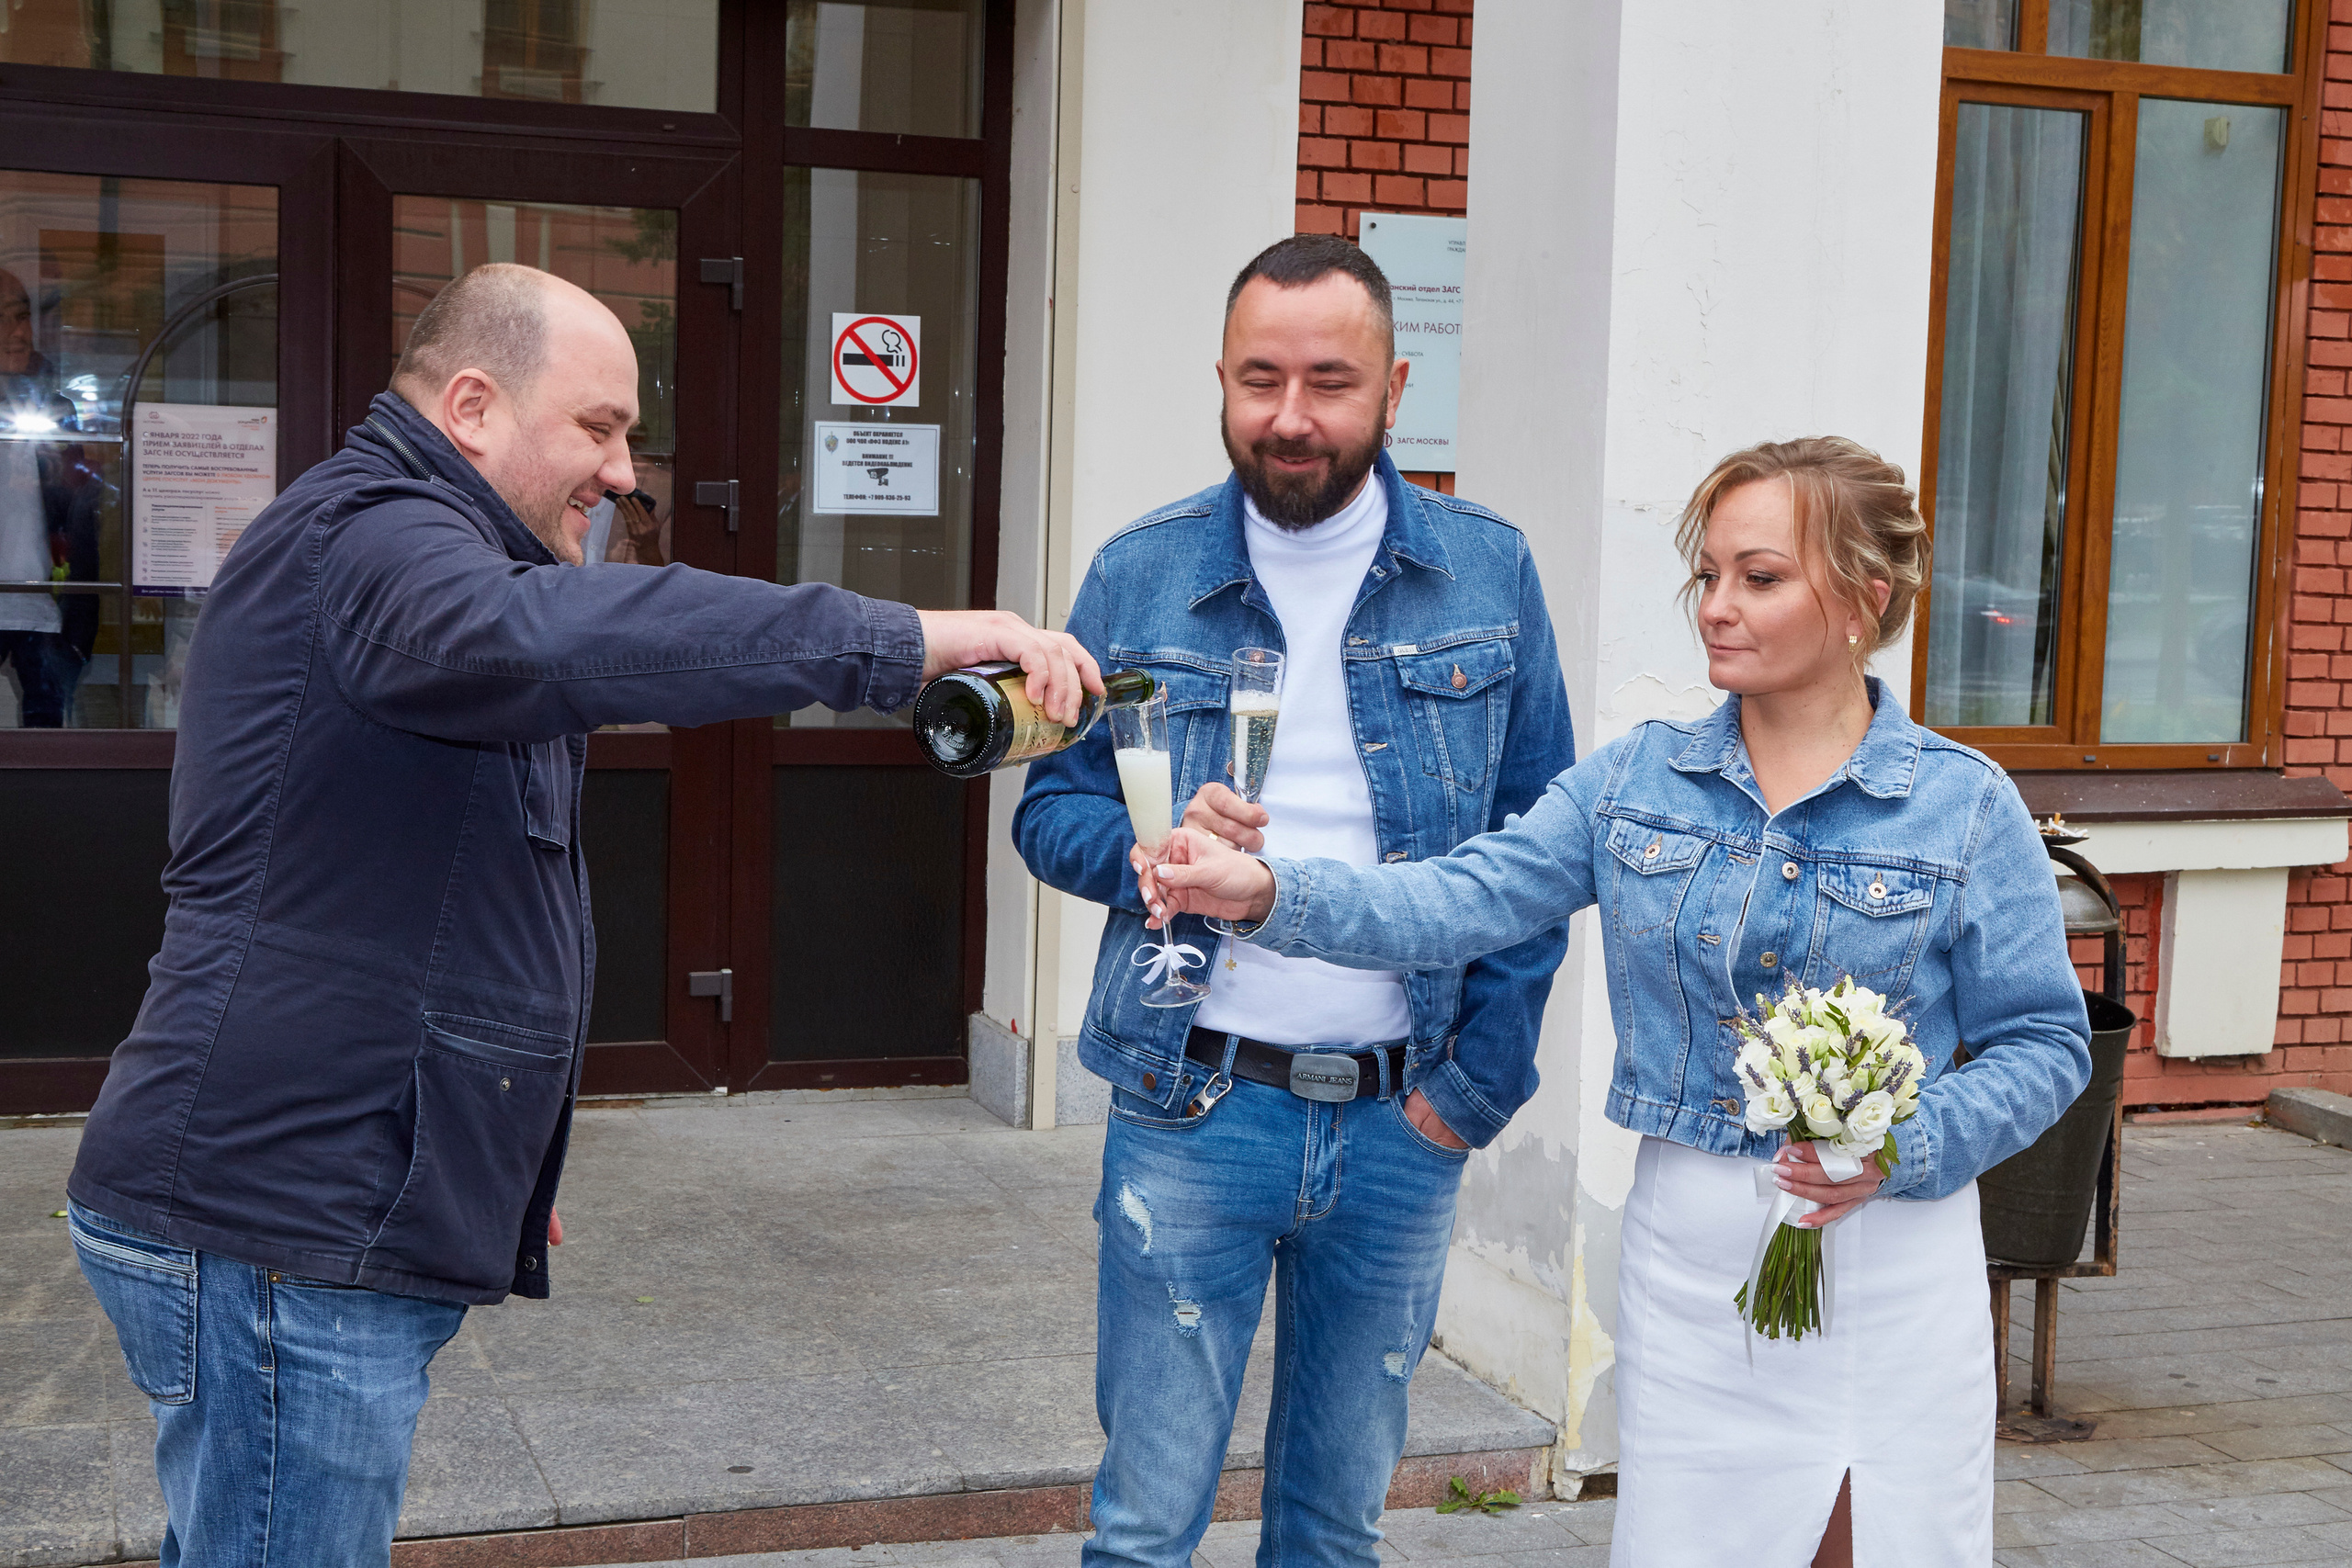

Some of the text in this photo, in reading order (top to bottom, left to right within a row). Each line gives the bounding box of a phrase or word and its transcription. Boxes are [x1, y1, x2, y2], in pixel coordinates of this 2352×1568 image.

[1442, 285, 1461, 294] ЗАГС
[1423, 321, 1463, 335] РАБОТ
[1396, 436, 1415, 445] ЗАГС
[172, 441, 220, 450] ЗАЯВИТЕЛЕЙ
[142, 448, 162, 457] ЗАГС
[175, 450, 245, 458] ОСУЩЕСТВЛЯЕТСЯ
[1296, 1072, 1352, 1085] ARMANI JEANS
